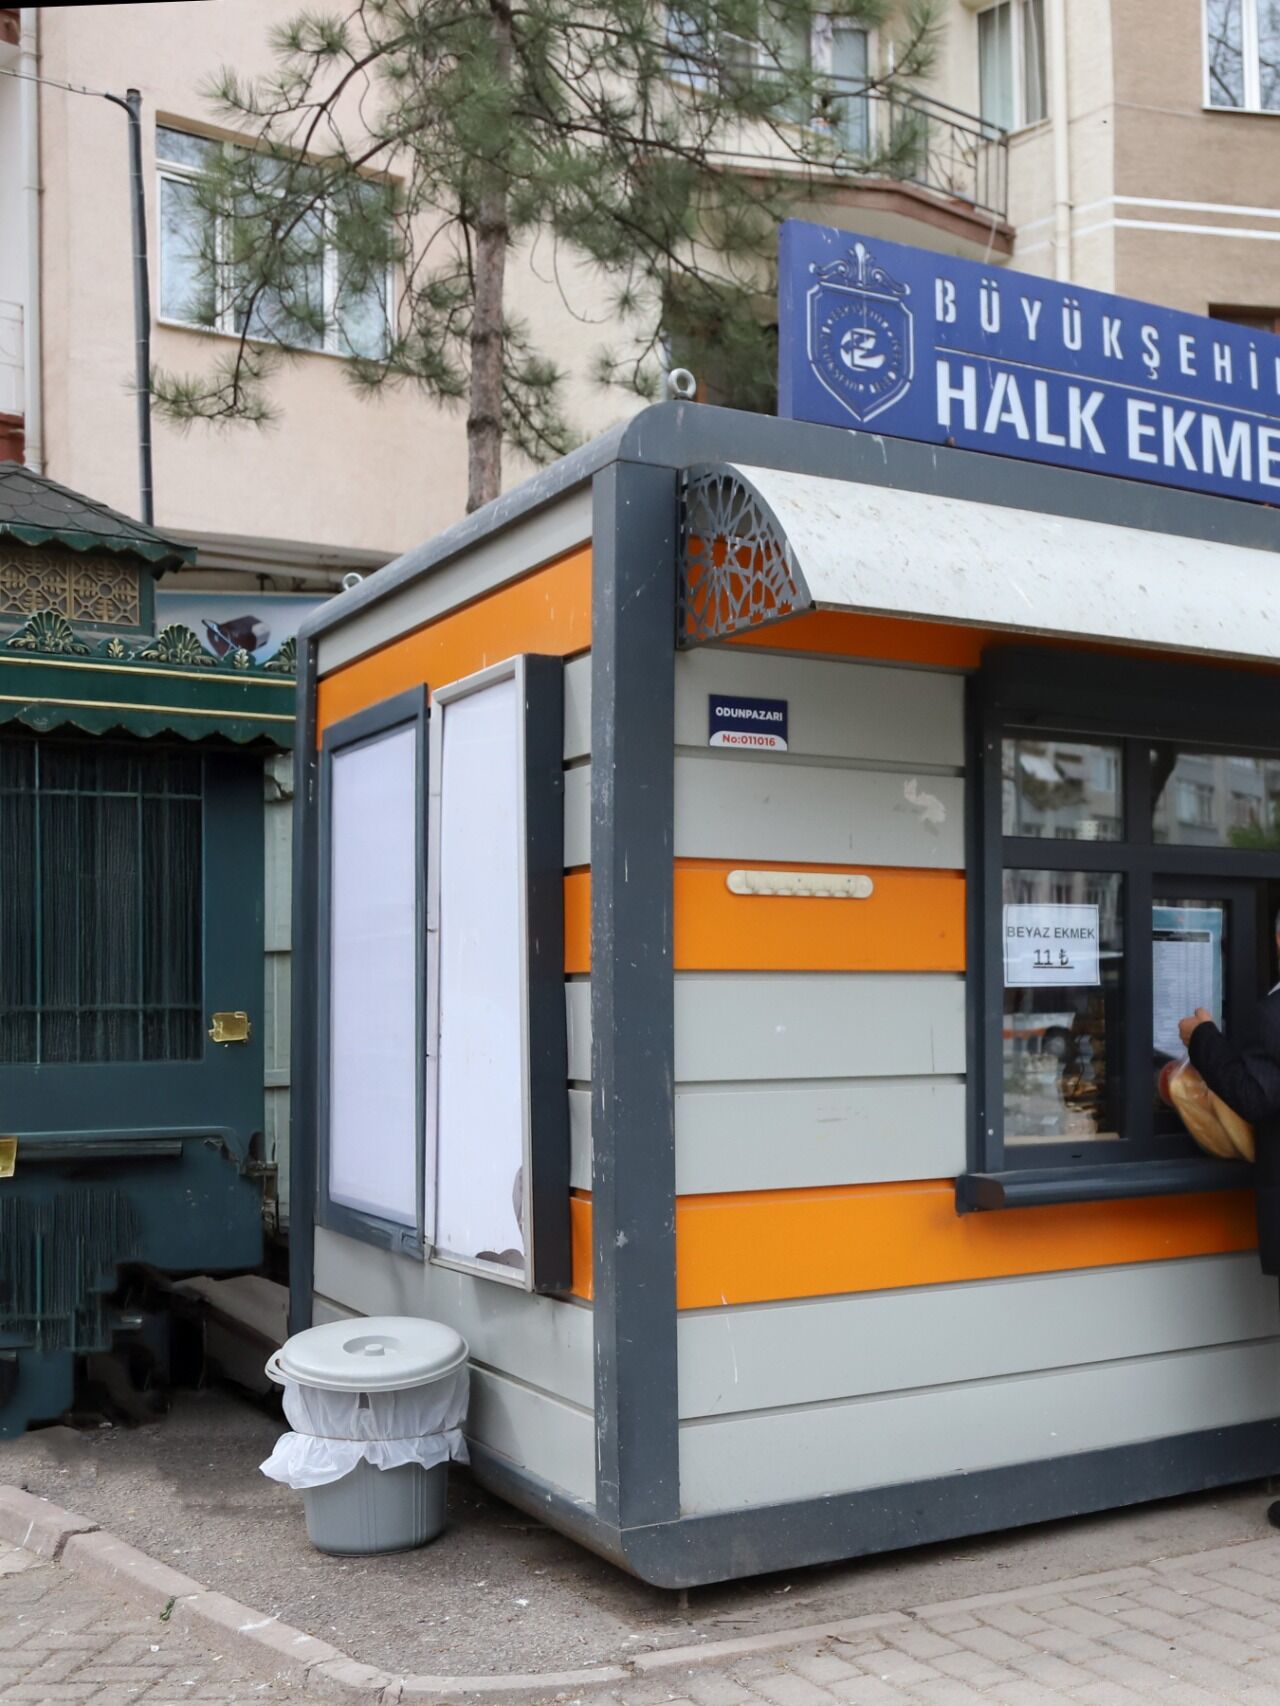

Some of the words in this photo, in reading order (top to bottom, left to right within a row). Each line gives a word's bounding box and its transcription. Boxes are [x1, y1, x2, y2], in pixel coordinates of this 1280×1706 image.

[935, 359, 1107, 455] HALK
[715, 706, 783, 721] ODUNPAZARI
[722, 734, 776, 747] No:011016
[1006, 926, 1050, 938] BEYAZ
[1054, 927, 1095, 939] EKMEK
[1033, 948, 1053, 966] 11
